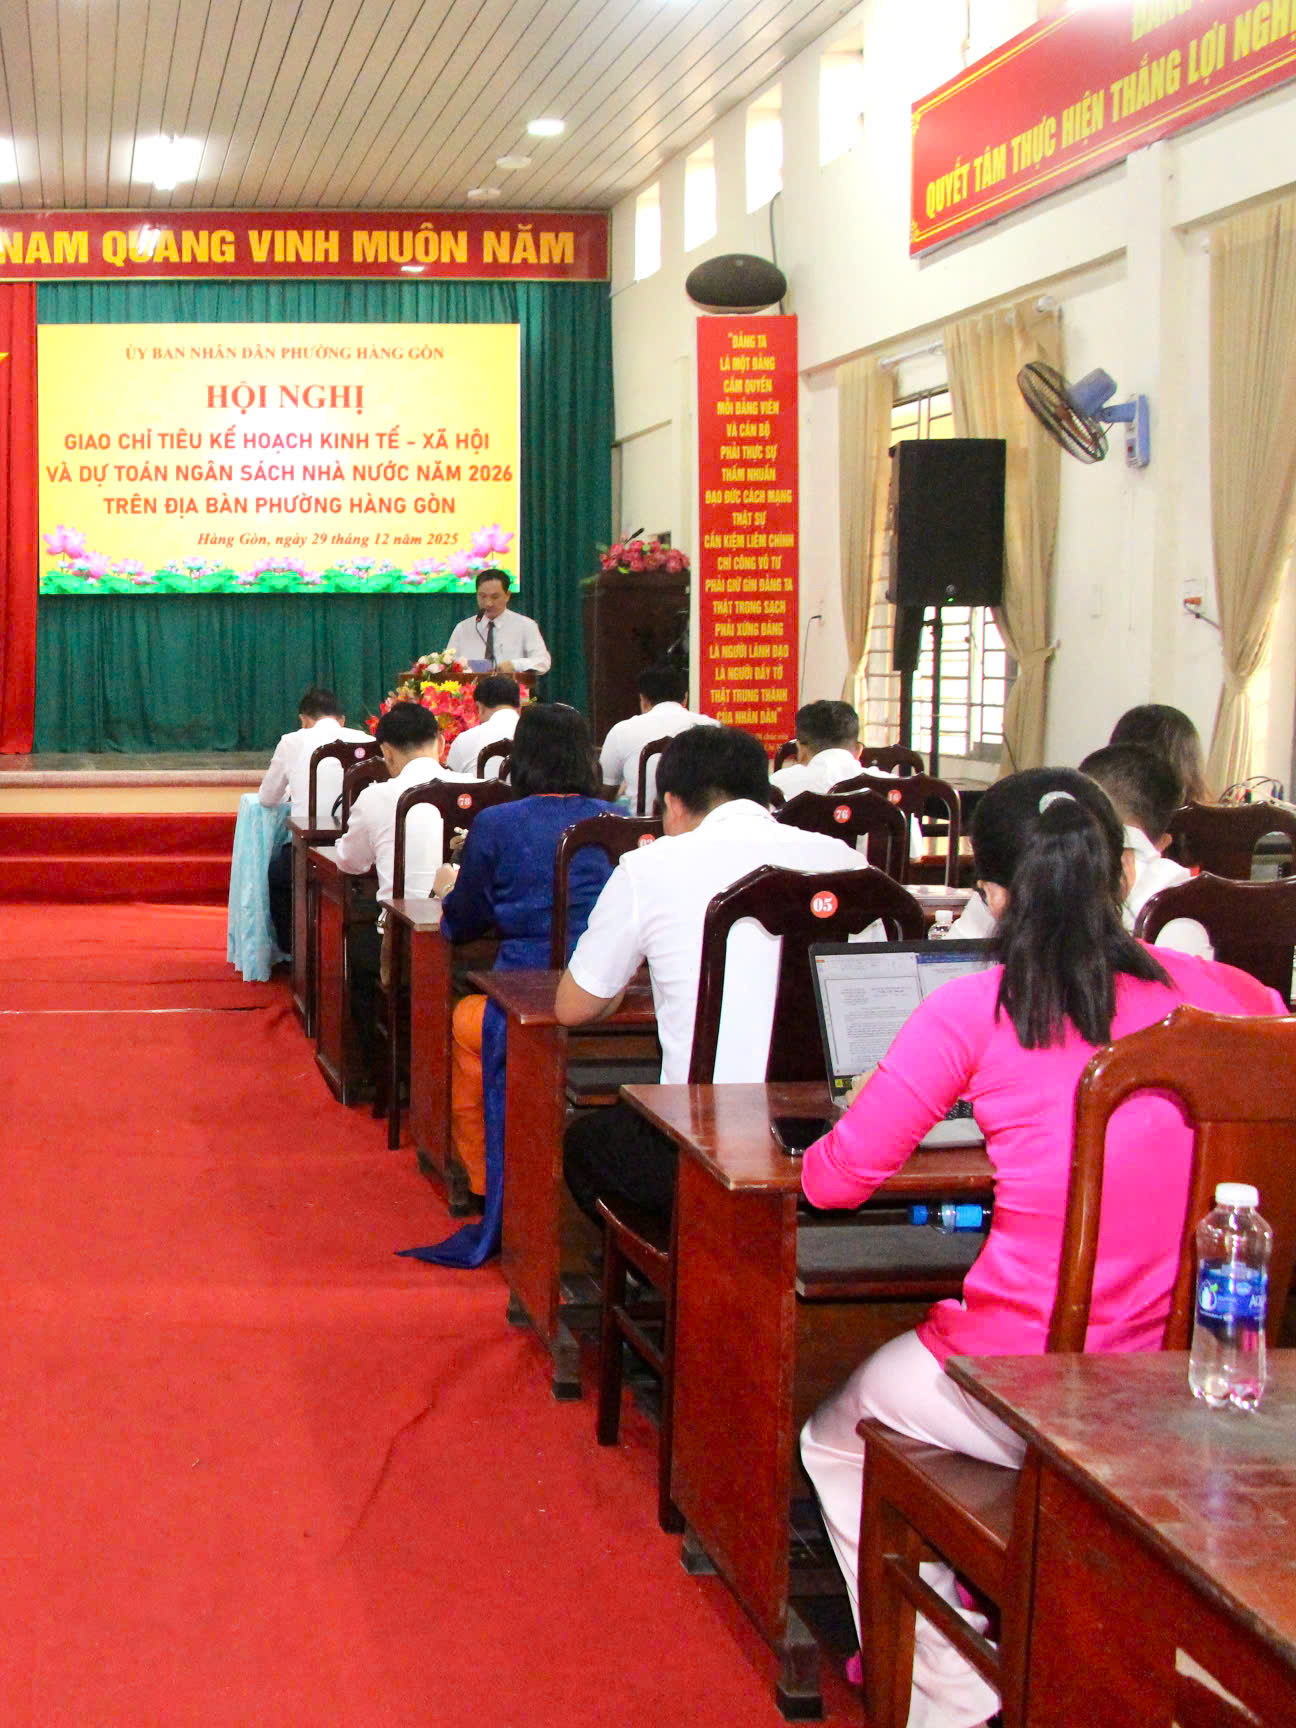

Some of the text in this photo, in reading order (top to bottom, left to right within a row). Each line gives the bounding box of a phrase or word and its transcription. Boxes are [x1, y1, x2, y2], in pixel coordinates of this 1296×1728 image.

[926, 156, 970, 219] QUYẾT
[974, 146, 1007, 192] TÂM
[1011, 116, 1056, 174] THỰC
[1062, 90, 1104, 149] HIỆN
[1110, 52, 1181, 123] THẮNG
[1188, 20, 1226, 85] LỢI
[102, 228, 235, 268] QUANG
[248, 229, 340, 264] VINH
[352, 223, 468, 265] MUÔN
[482, 224, 575, 265] NĂM
[125, 344, 444, 360] ỦY BAN NHÂN DÂN PHƯỜNG HÀNG GÒN
[206, 381, 364, 415] HỘI NGHỊ
[64, 433, 111, 450] GIAO
[118, 428, 152, 449] CHỈ
[158, 427, 202, 449] TIÊU
[210, 424, 236, 449] KẾ
[243, 432, 312, 454] HOẠCH
[320, 432, 368, 449] KINH
[376, 424, 400, 449] TẾ
[423, 427, 449, 450] XÃ
[456, 427, 489, 455] HỘI
[46, 459, 513, 488] VÀ DỰ TOÁN NGÂN SÁCH NHÀ NƯỚC NĂM 2026
[104, 492, 456, 519] TRÊN ĐỊA BÀN PHƯỜNG HÀNG GÒN
[197, 533, 459, 548] Hàng Gòn, ngày 29 tháng 12 năm 2025
[813, 897, 833, 912] 05
